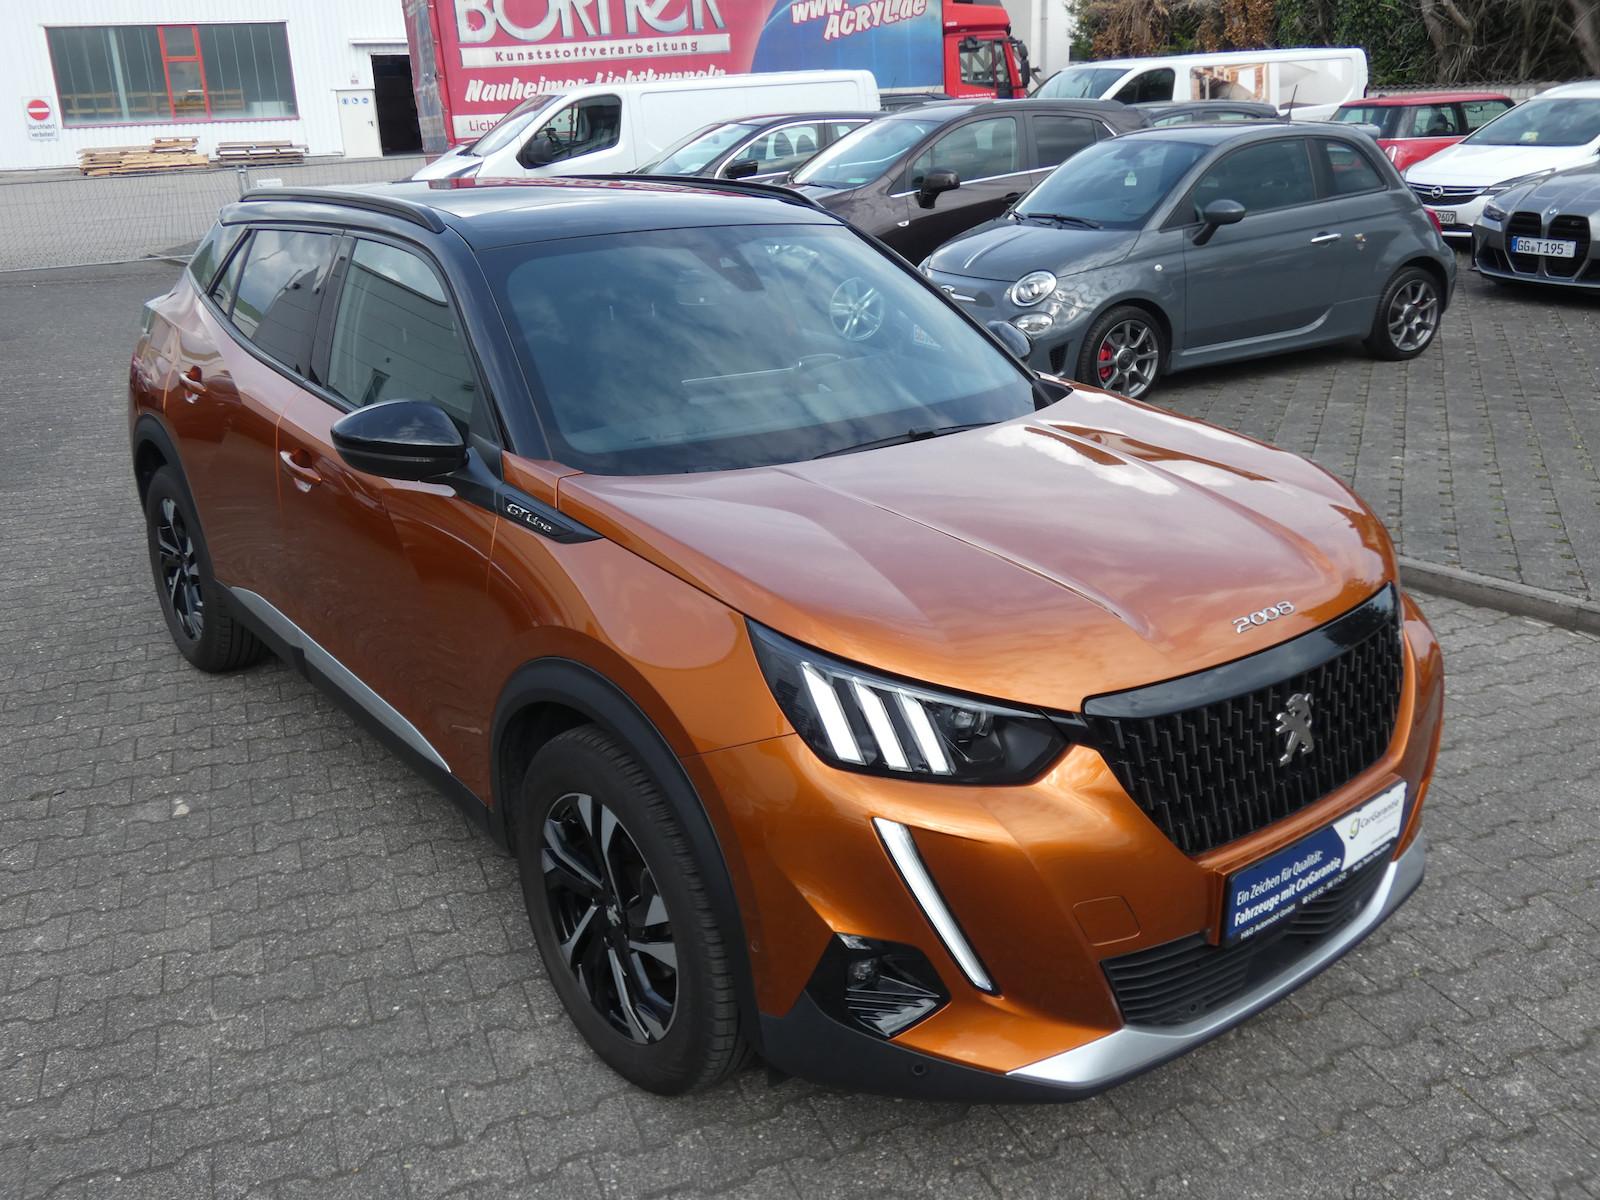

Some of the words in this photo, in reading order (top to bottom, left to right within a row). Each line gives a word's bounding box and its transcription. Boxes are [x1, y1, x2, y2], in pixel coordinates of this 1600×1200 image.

[495, 41, 698, 61] Kunststoffverarbeitung
[1517, 239, 1530, 252] GG
[1232, 601, 1294, 634] 2008
[1234, 894, 1280, 927] Fahrzeuge
[1280, 883, 1296, 902] mit
[1295, 857, 1342, 892] CarGarantie
[1236, 890, 1249, 906] Ein
[1250, 874, 1280, 899] Zeichen
[1281, 866, 1294, 882] für
